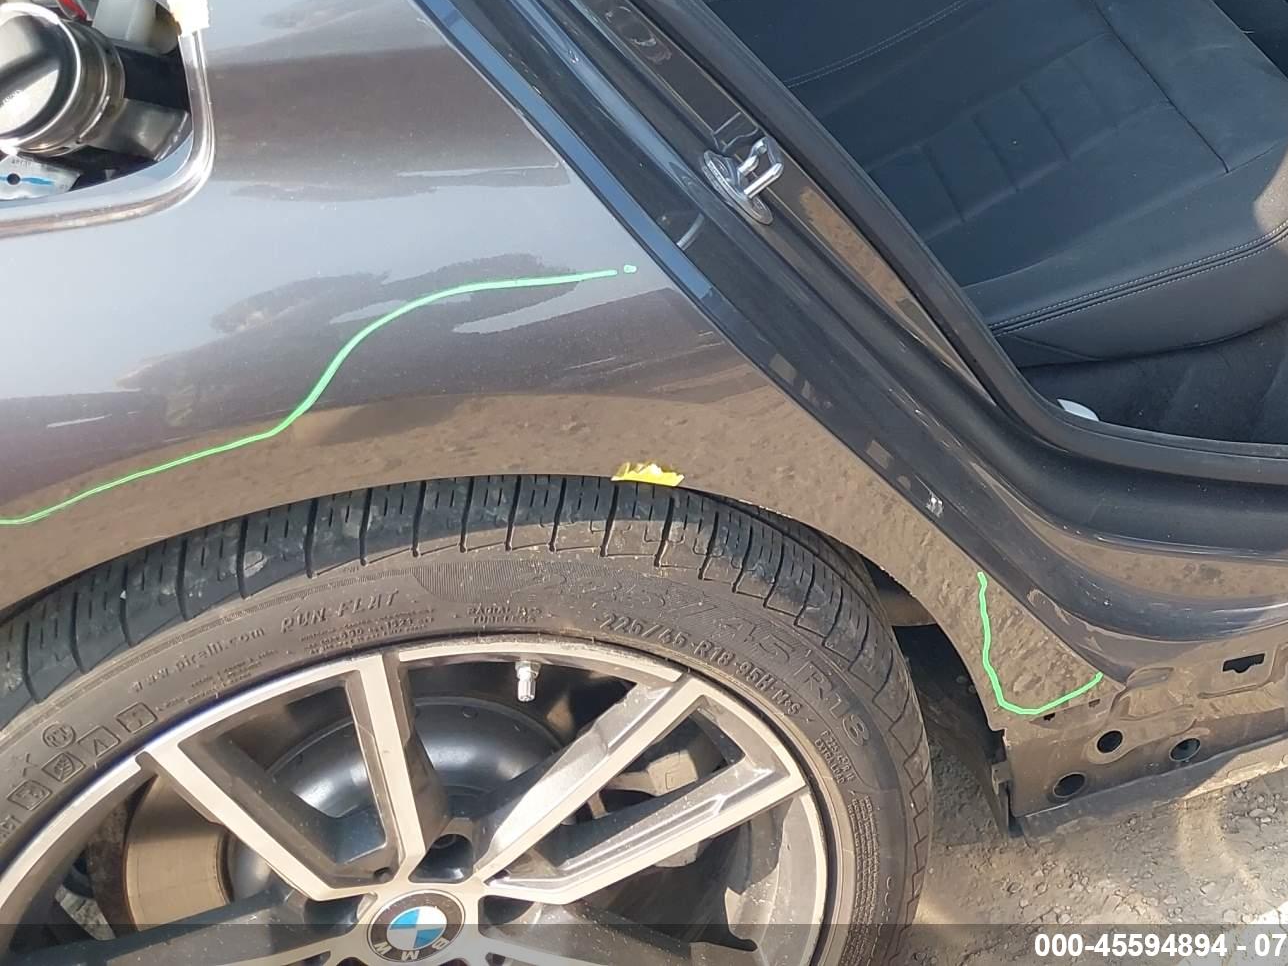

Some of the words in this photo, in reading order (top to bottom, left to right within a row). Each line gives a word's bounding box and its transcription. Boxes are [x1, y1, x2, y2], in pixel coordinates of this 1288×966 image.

[280, 606, 328, 634] RUN
[336, 588, 400, 618] FLAT
[693, 639, 736, 667] R18
